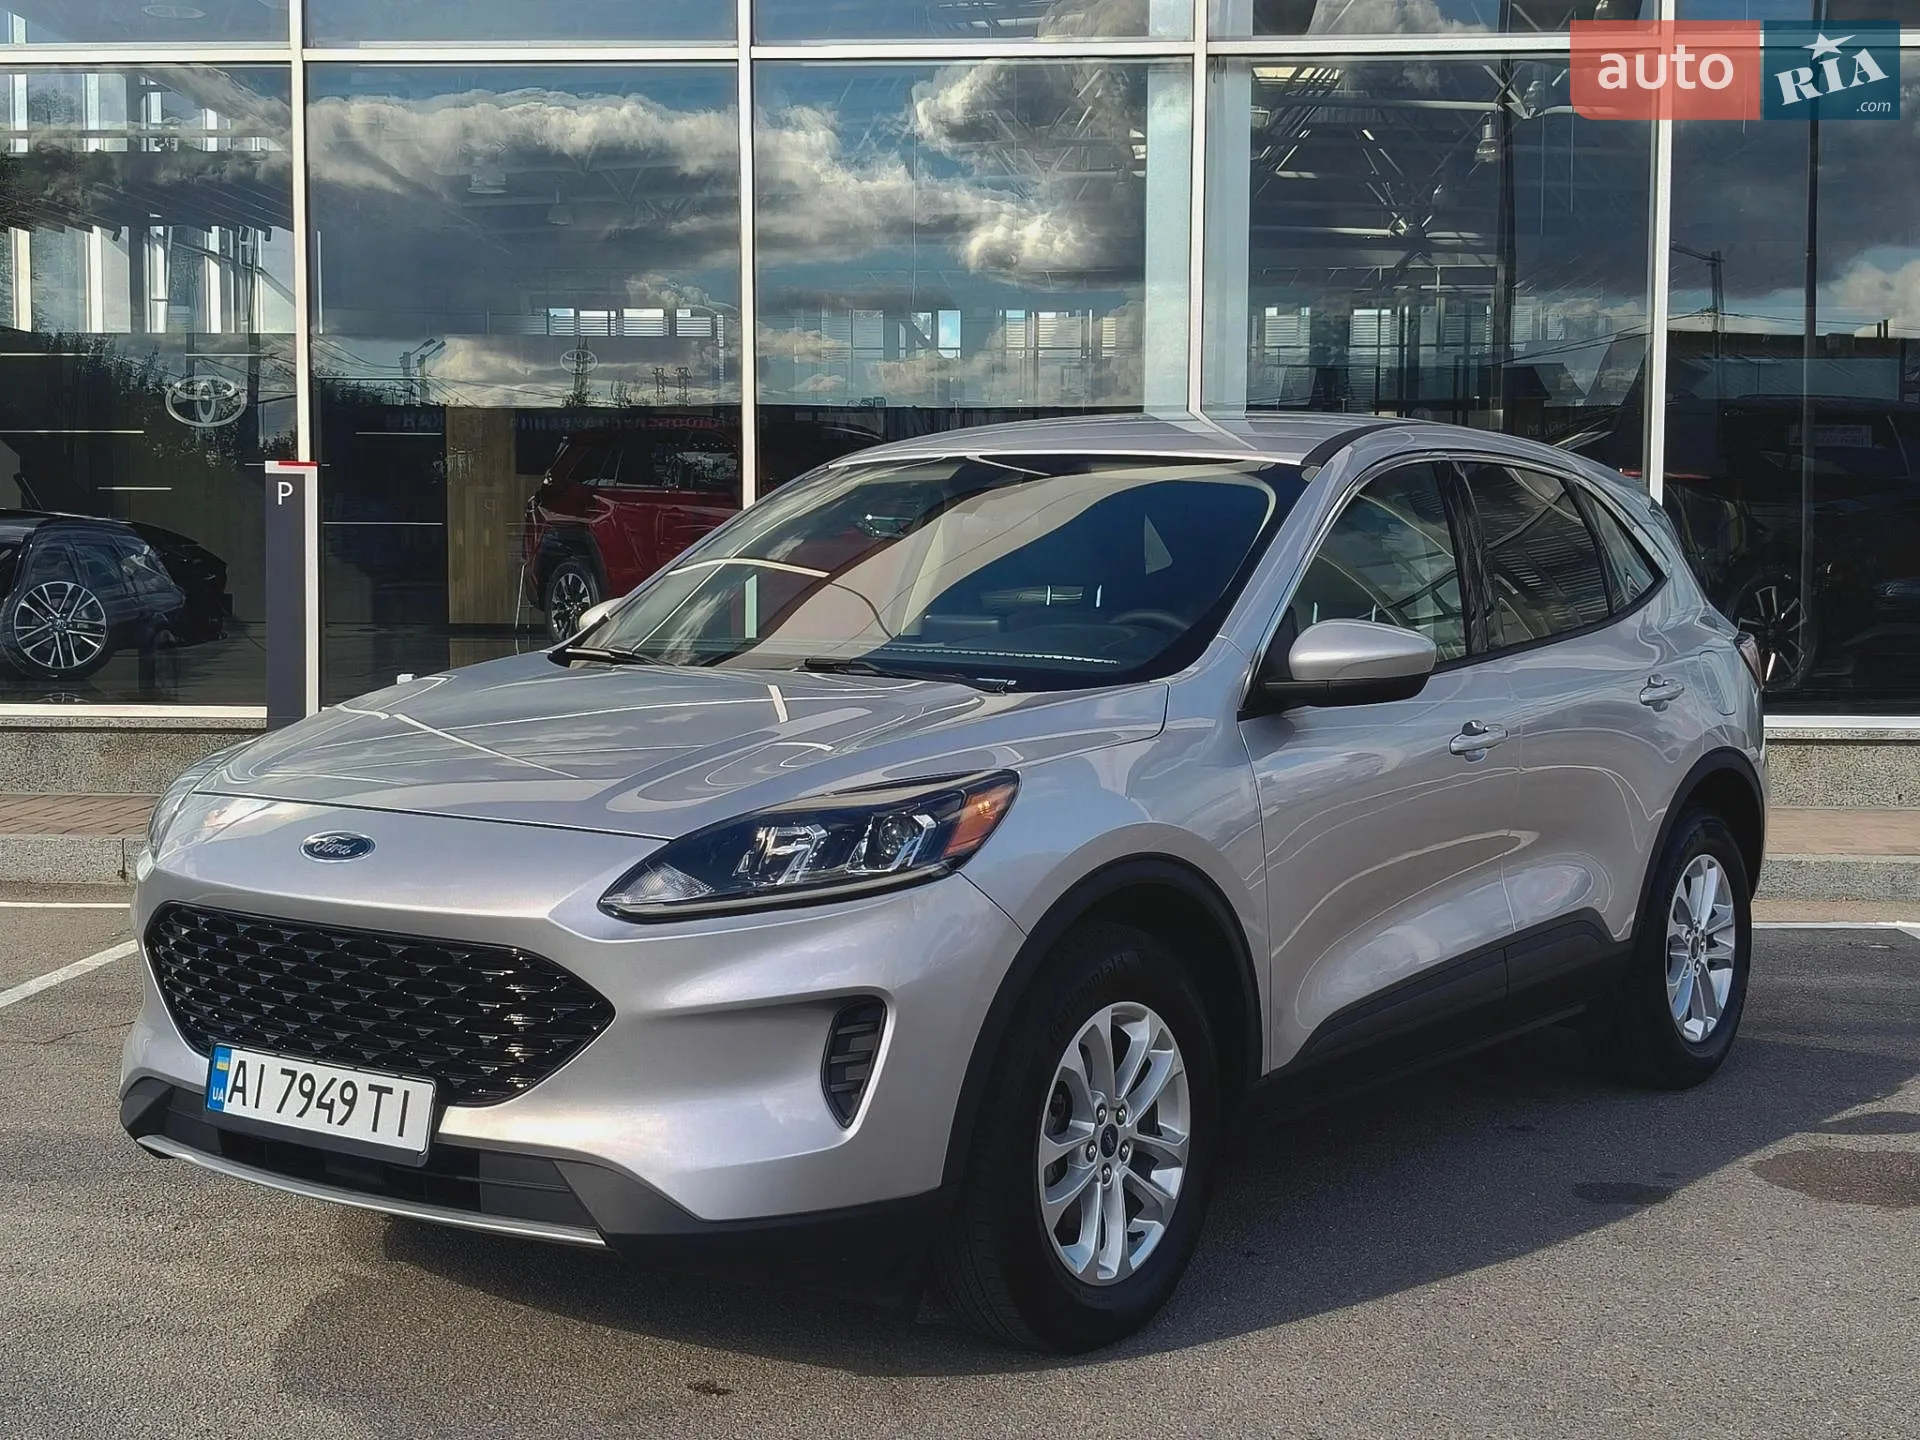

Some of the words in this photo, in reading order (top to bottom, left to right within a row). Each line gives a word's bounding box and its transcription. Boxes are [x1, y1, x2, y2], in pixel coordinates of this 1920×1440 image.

[278, 482, 293, 505] P
[313, 836, 357, 855] Ford
[212, 1086, 224, 1101] UA
[228, 1060, 265, 1109] AI
[276, 1068, 358, 1126] 7949
[368, 1084, 410, 1137] TI
